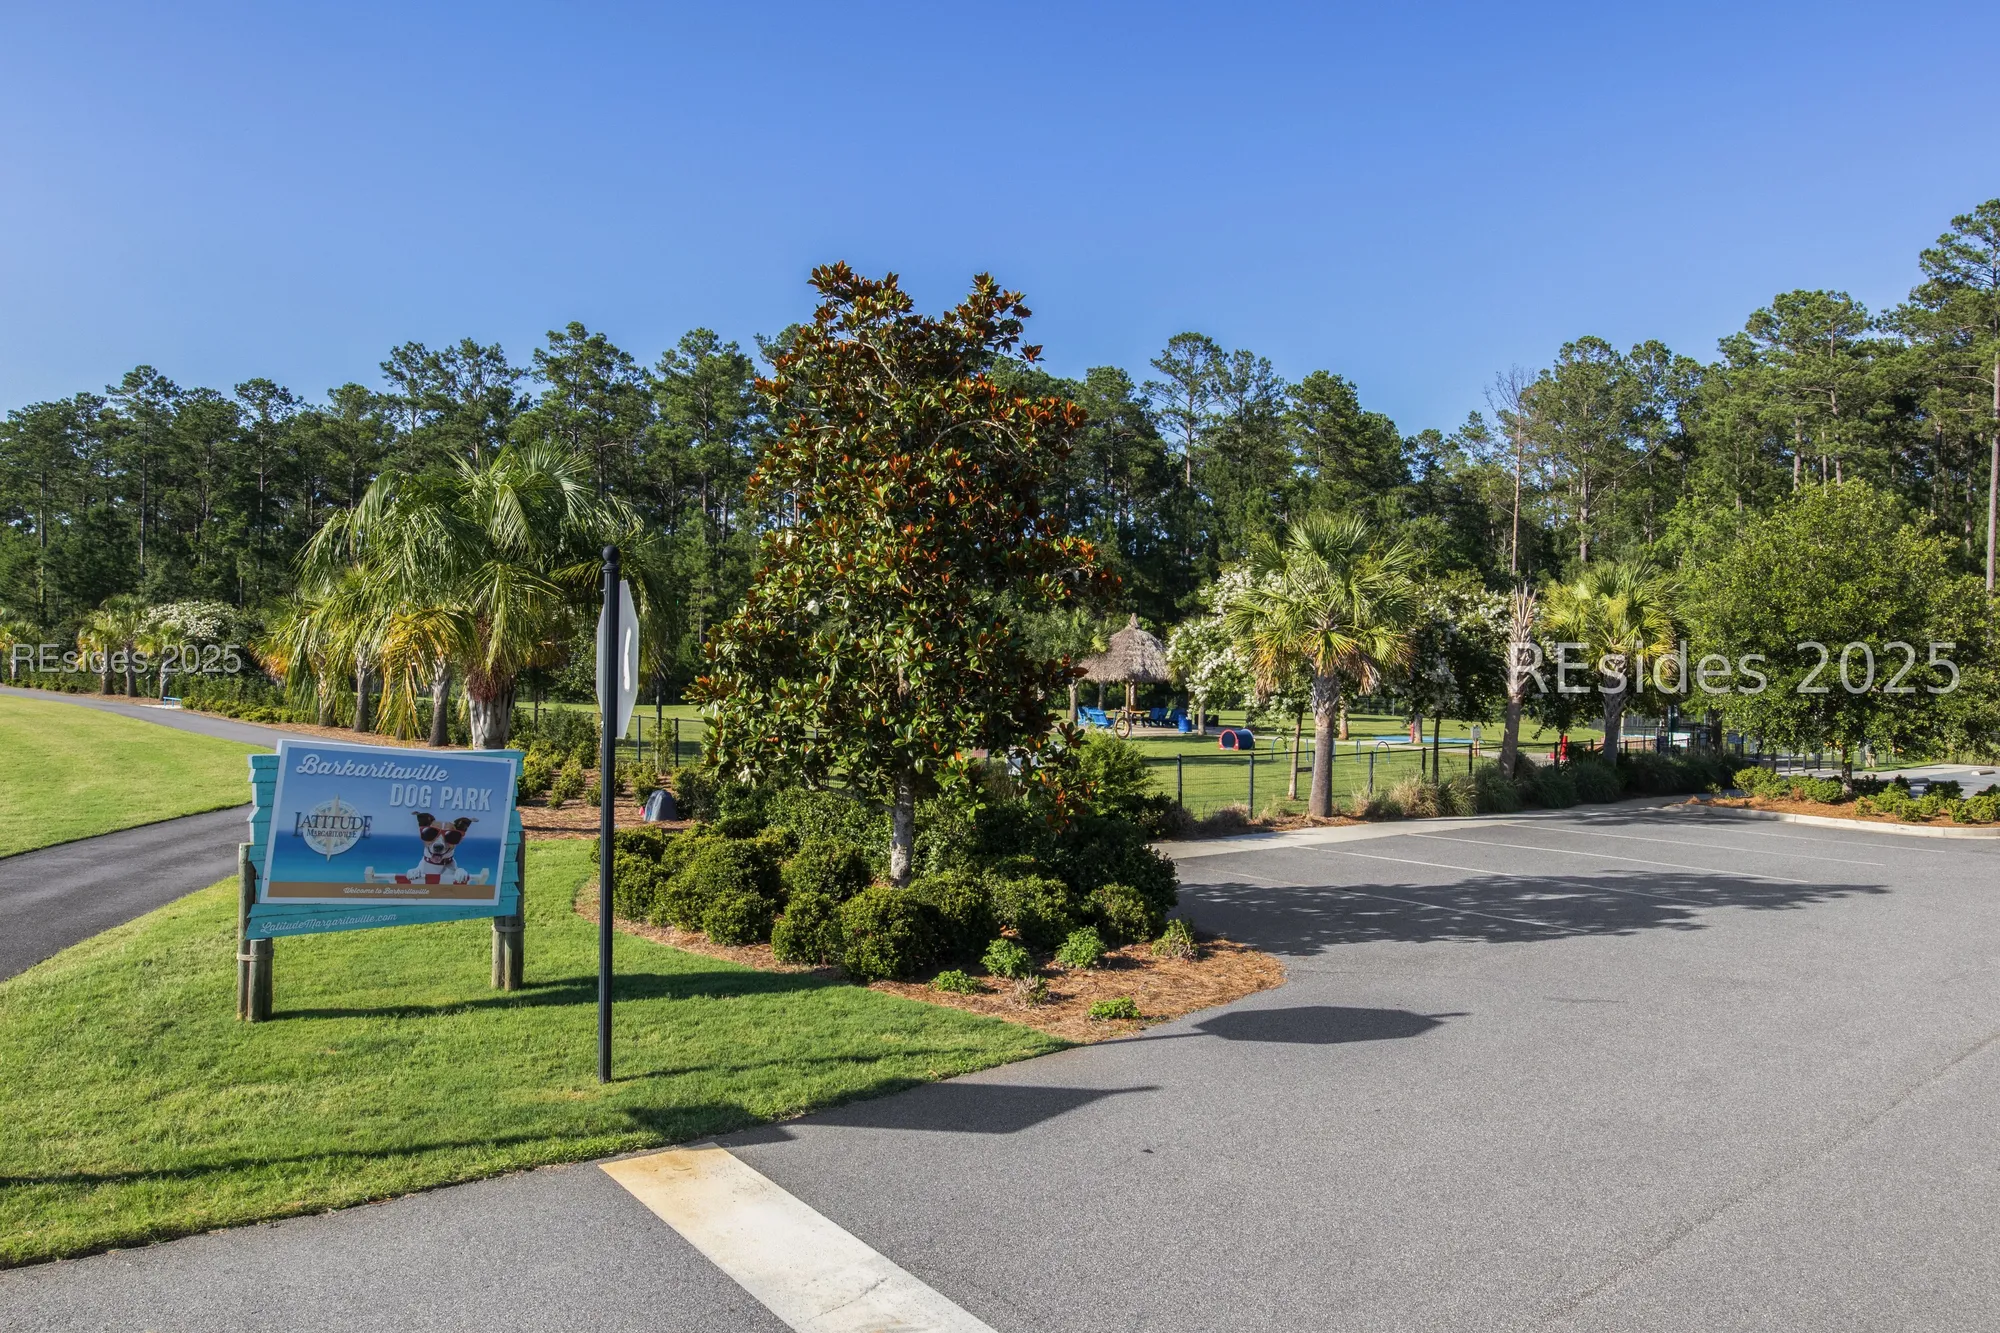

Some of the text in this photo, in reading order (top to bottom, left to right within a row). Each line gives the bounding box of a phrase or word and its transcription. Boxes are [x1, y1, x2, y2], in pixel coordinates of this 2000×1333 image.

[296, 754, 449, 782] Barkaritaville
[389, 783, 493, 811] DOG PARK
[292, 811, 373, 839] LATITUDE
[343, 886, 375, 894] Welcome
[383, 887, 430, 895] Barkaritaville
[260, 914, 397, 934] LatitudeMargaritaville.com
